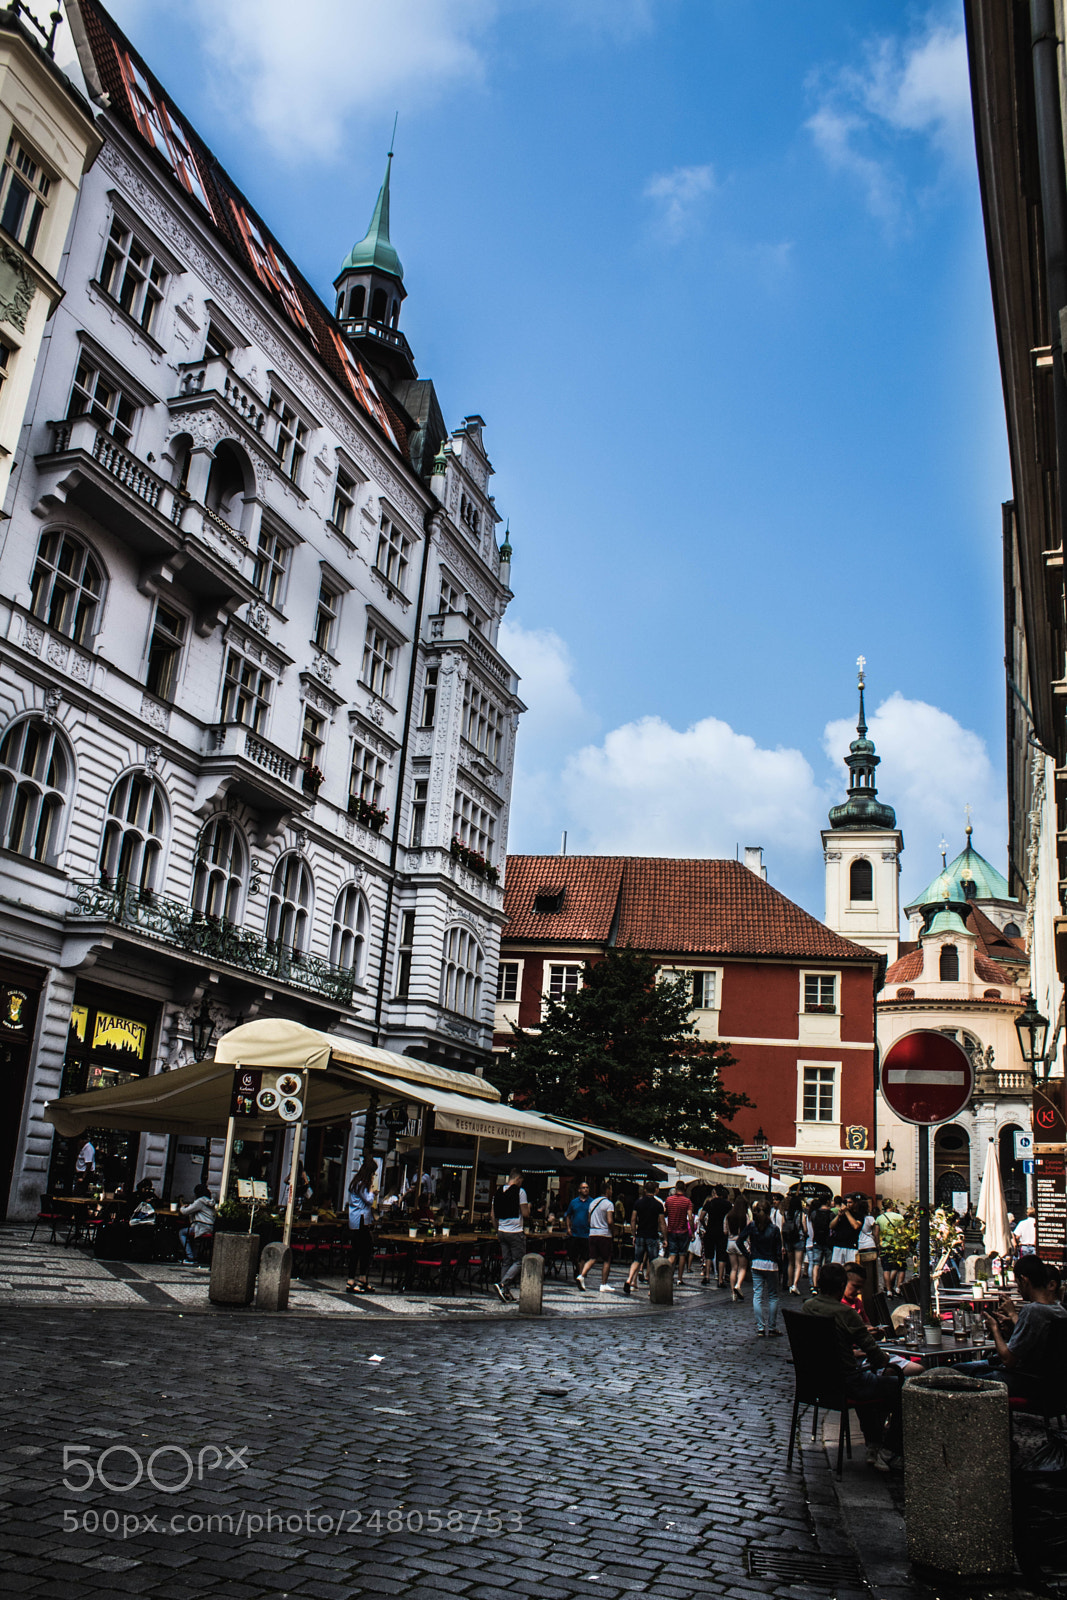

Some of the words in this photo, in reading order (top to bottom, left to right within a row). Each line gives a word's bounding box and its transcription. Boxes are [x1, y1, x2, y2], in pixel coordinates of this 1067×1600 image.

[95, 1015, 146, 1048] MARKET
[1042, 1110, 1055, 1123] K1
[455, 1118, 495, 1135] RESTAURACE
[497, 1127, 522, 1138] KARLOVA
